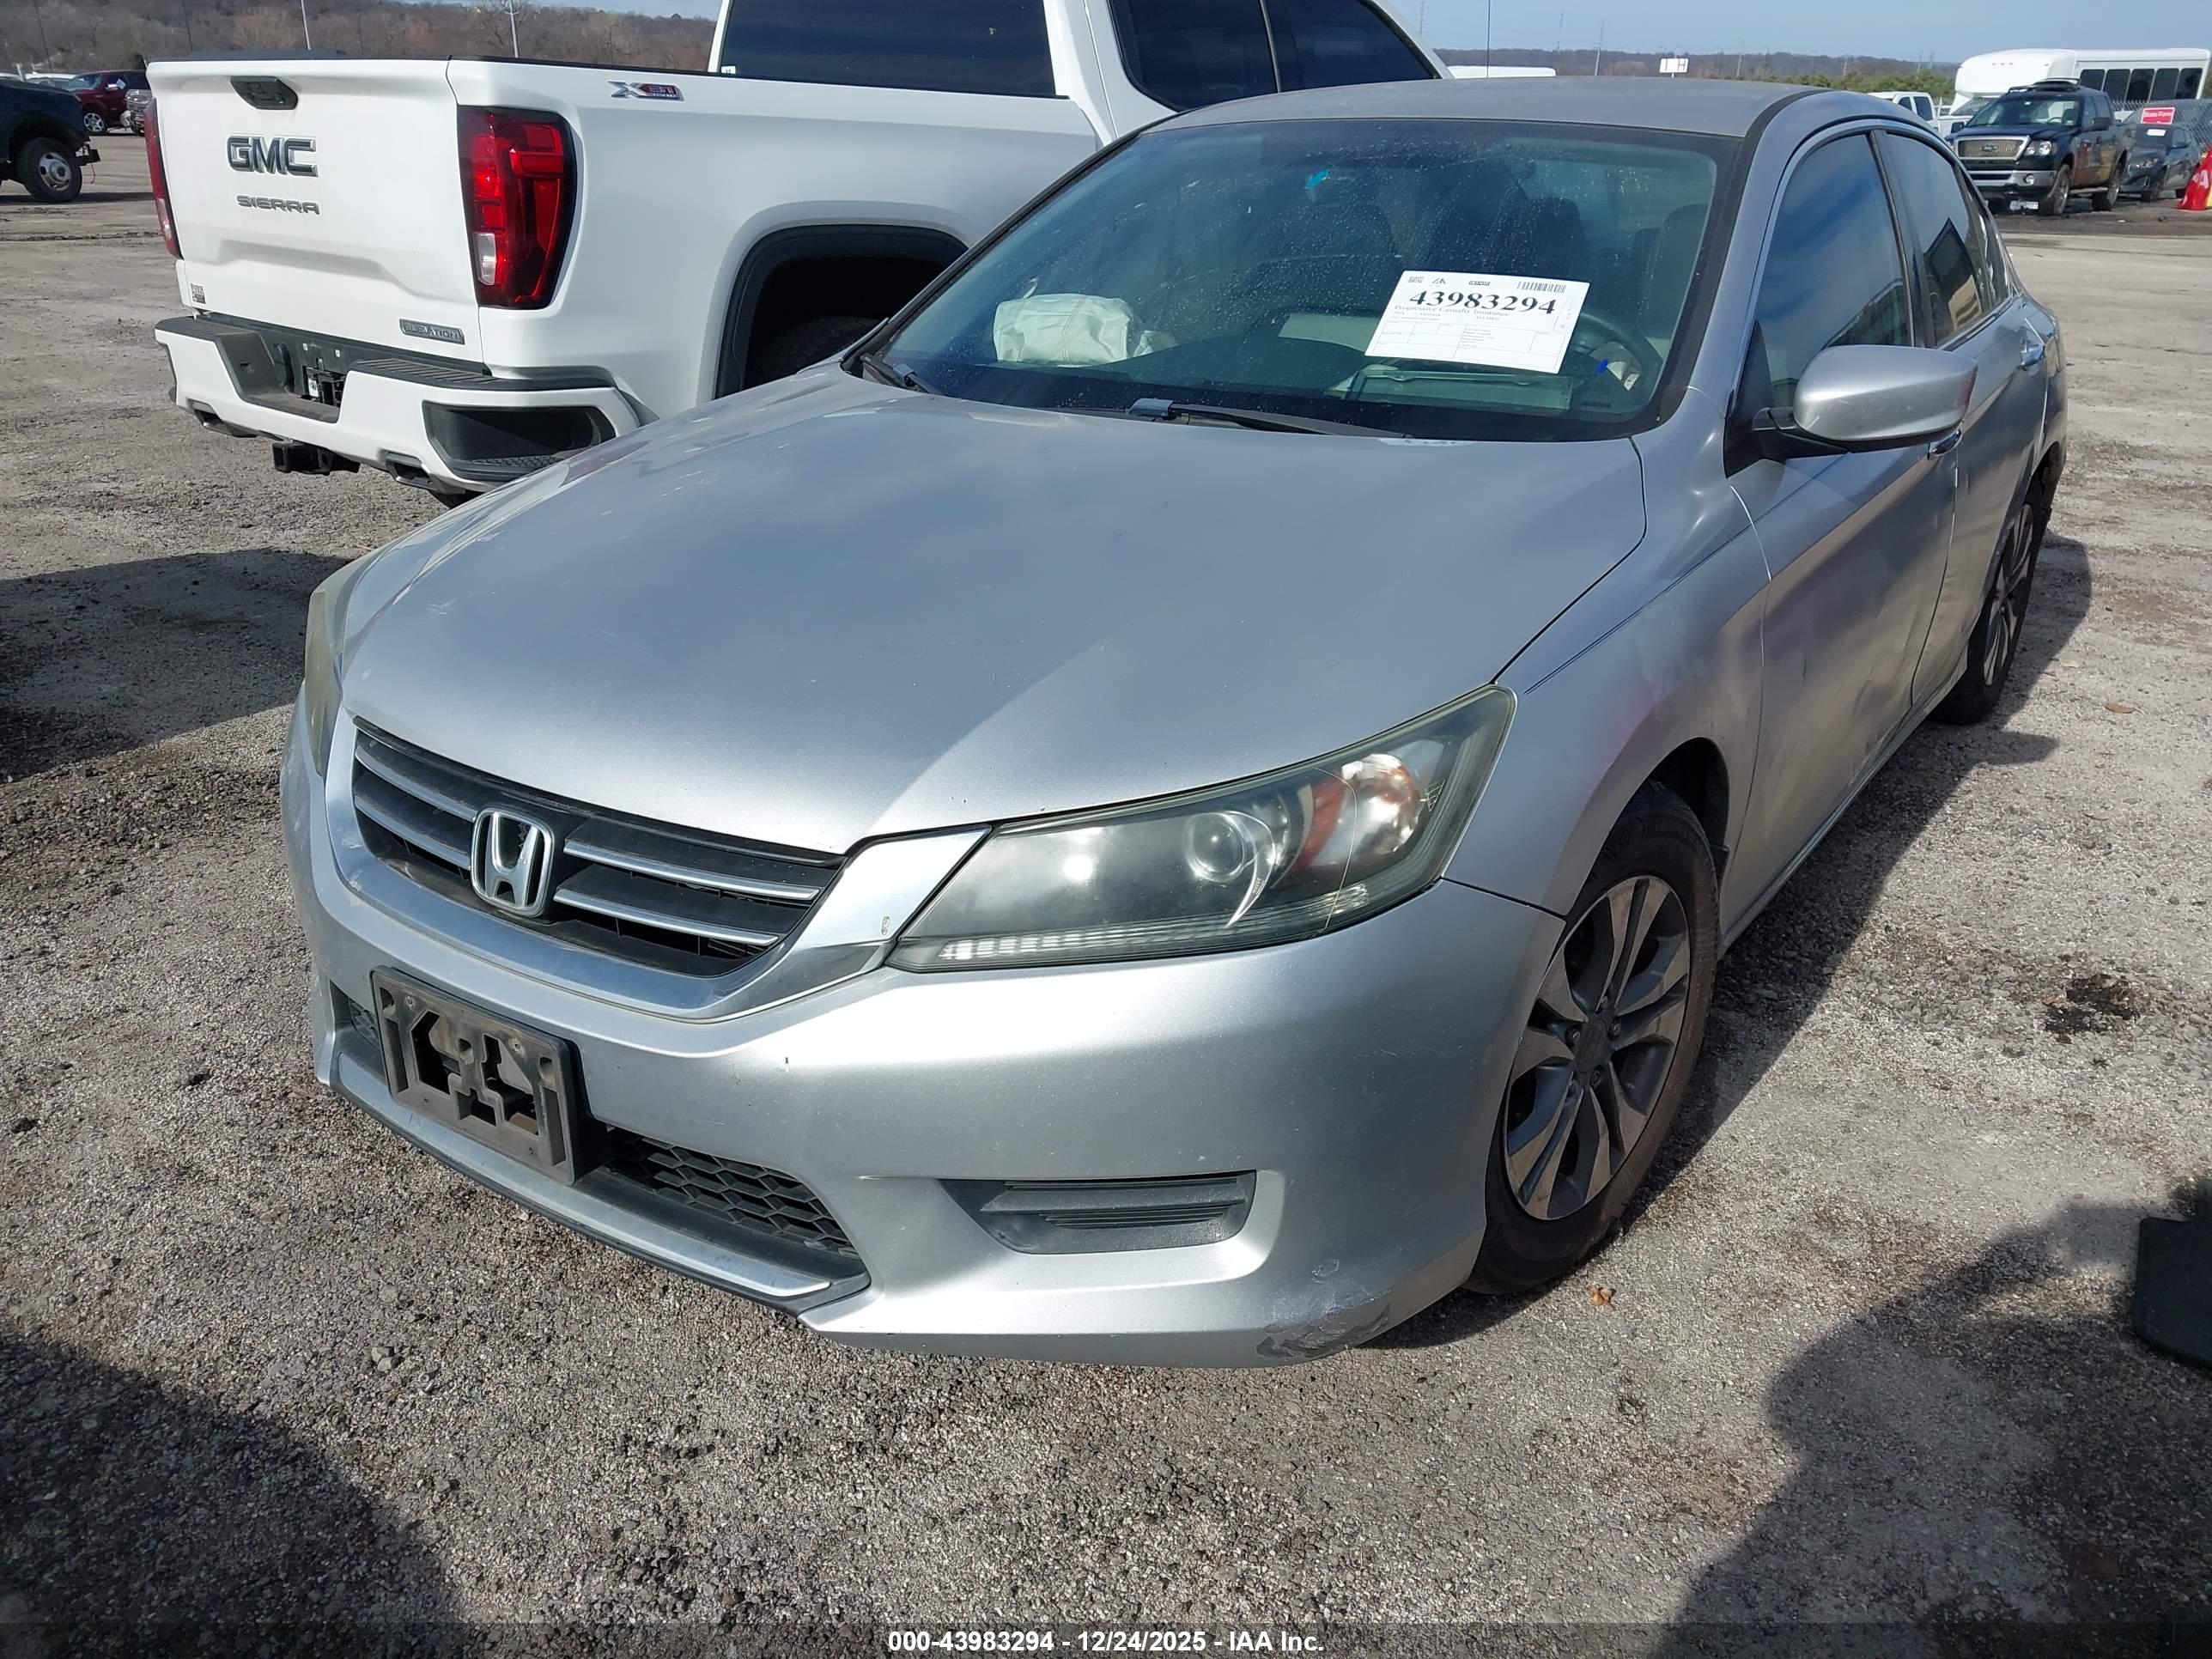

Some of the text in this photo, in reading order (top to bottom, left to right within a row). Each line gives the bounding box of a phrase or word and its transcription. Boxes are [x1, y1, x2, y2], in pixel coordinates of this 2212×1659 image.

[227, 135, 319, 178] GMC
[236, 195, 320, 215] SIERRA
[1409, 290, 1557, 314] 43983294
[403, 321, 461, 339] ELEVATION
